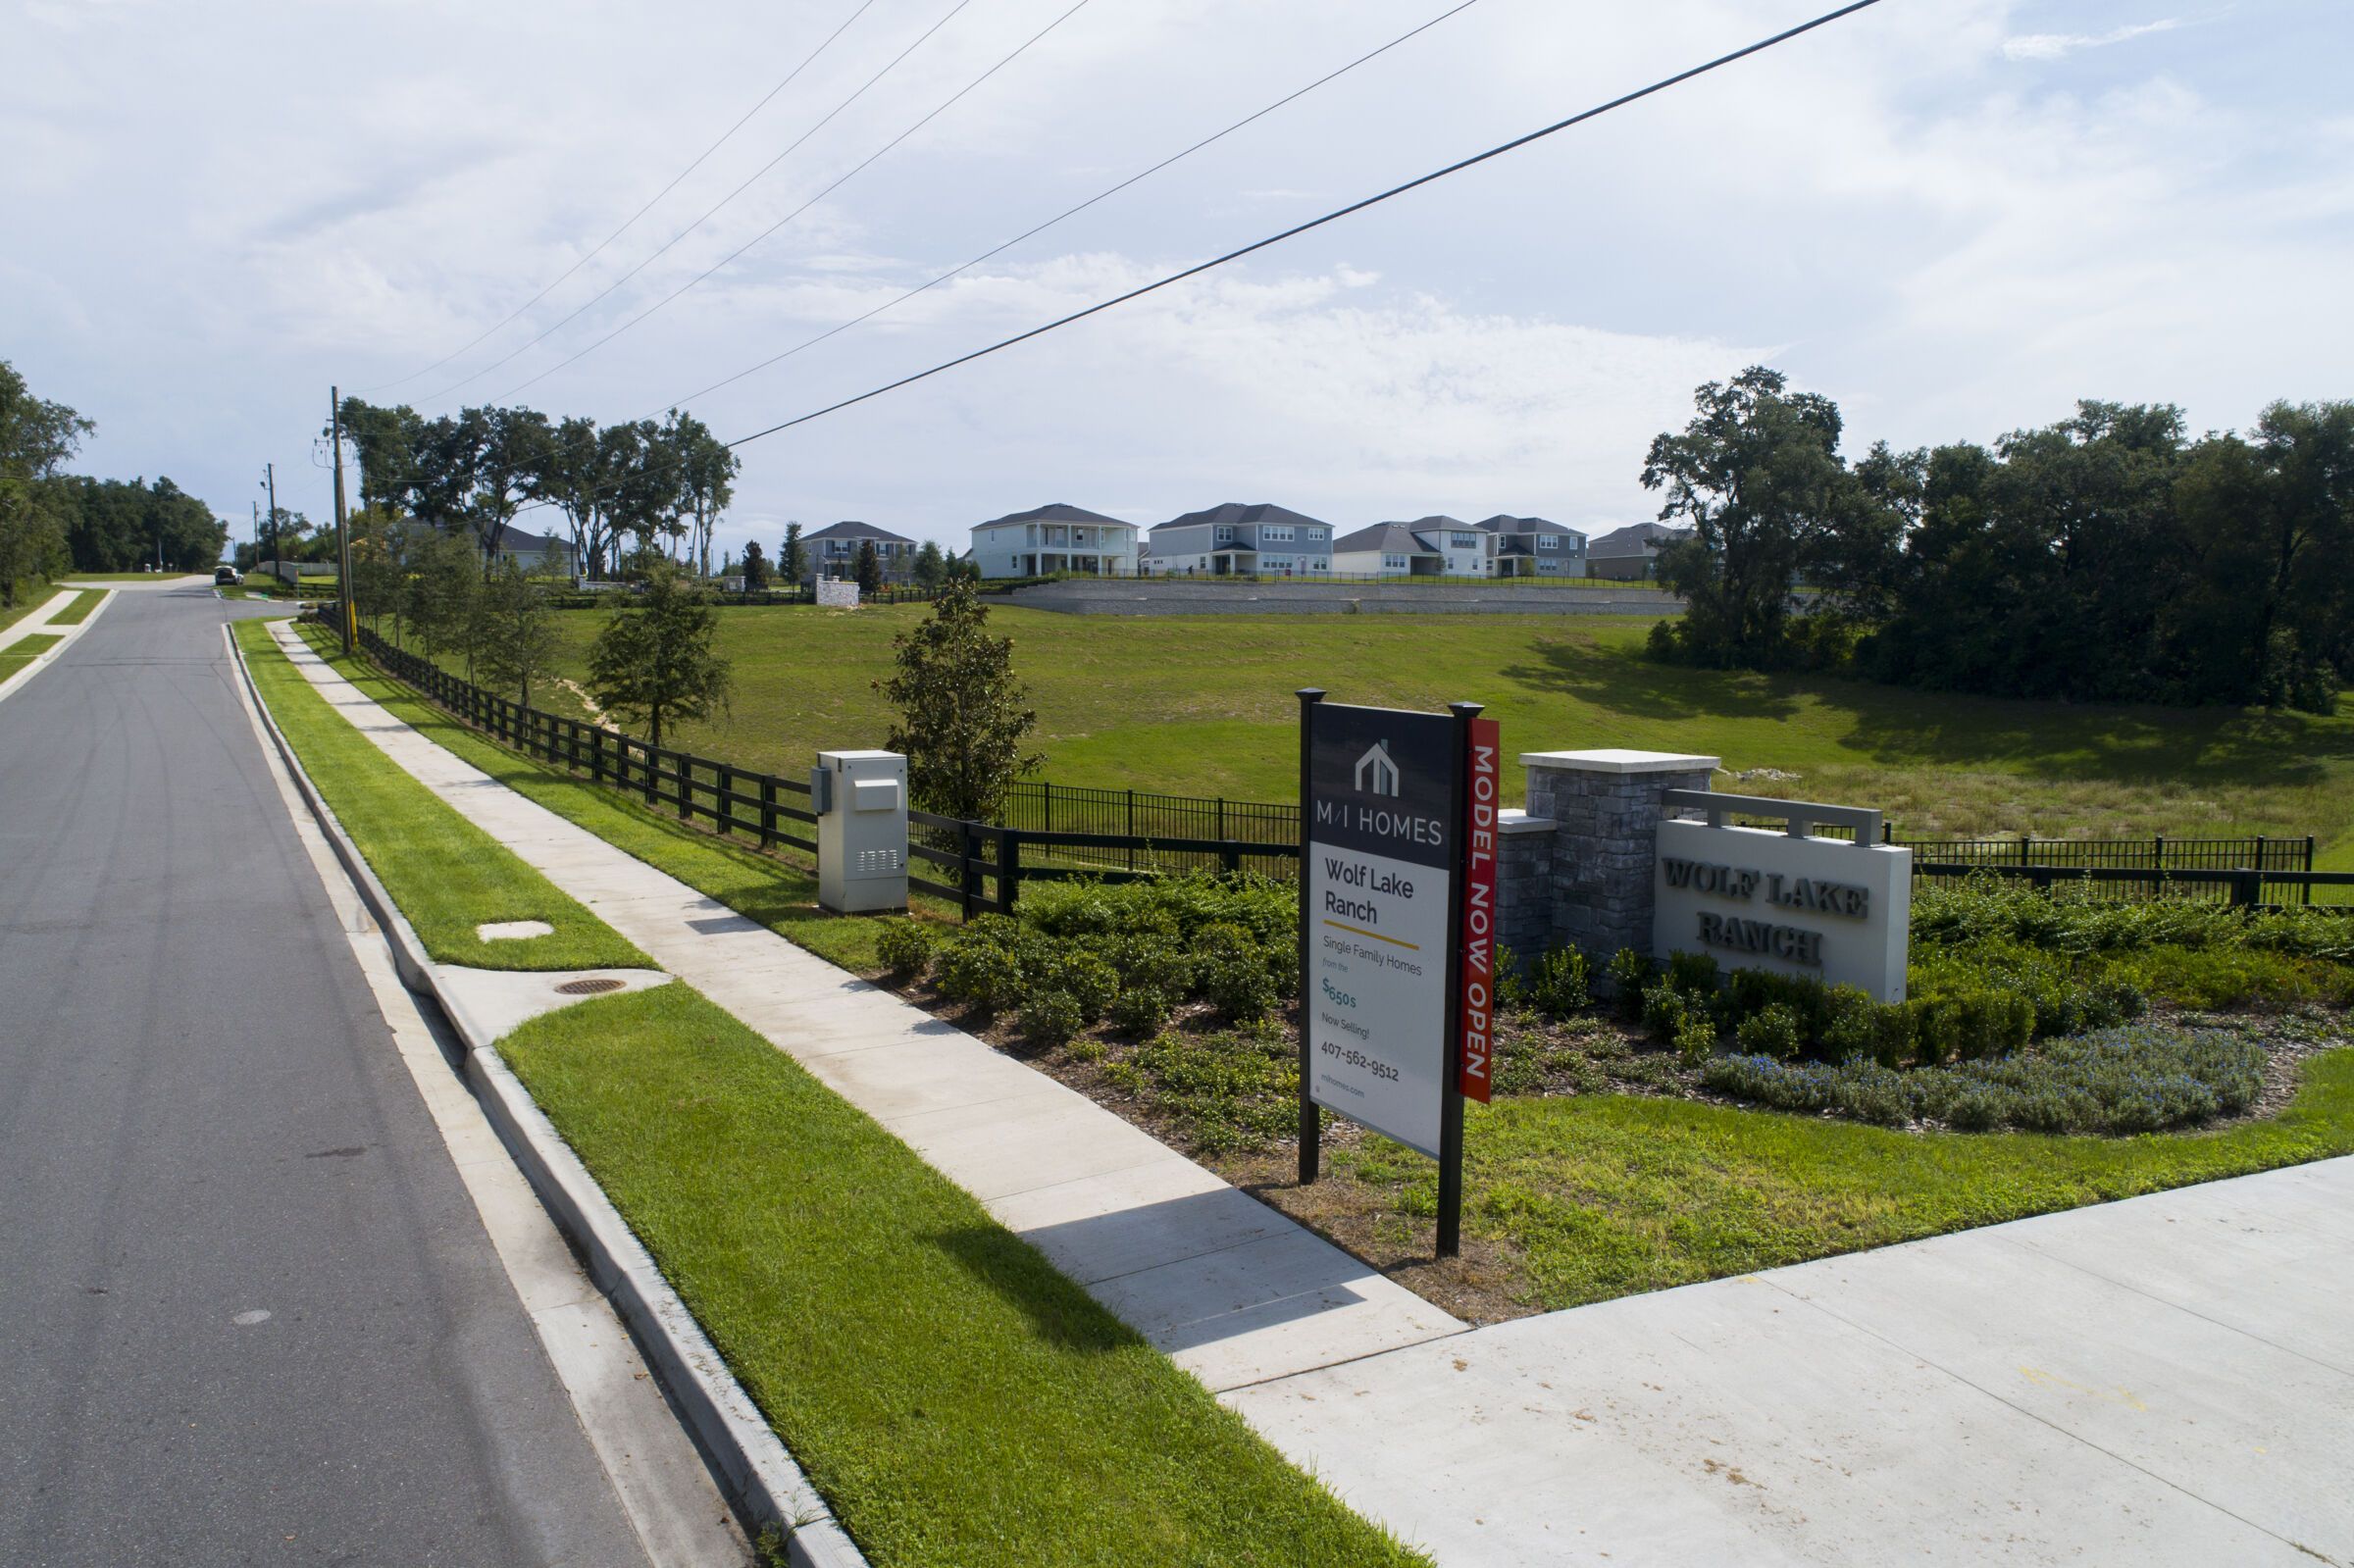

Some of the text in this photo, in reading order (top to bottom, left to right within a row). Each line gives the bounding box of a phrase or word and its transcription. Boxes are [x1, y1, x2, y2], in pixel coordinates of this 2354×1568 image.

[1359, 807, 1442, 846] HOMES
[1325, 857, 1414, 899] Wolf Lake
[1662, 857, 1869, 920] WOLF LAKE
[1325, 890, 1377, 924] Ranch
[1466, 745, 1494, 1080] MODEL NOW OPEN
[1323, 935, 1422, 976] Single Family Homes
[1696, 911, 1823, 967] RANCH
[1322, 957, 1349, 973] from the
[1322, 977, 1356, 1008] $650s
[1322, 1011, 1370, 1040] Now Selling!
[1321, 1041, 1399, 1082] 407-562-9512
[1321, 1074, 1364, 1098] mihomes.com
